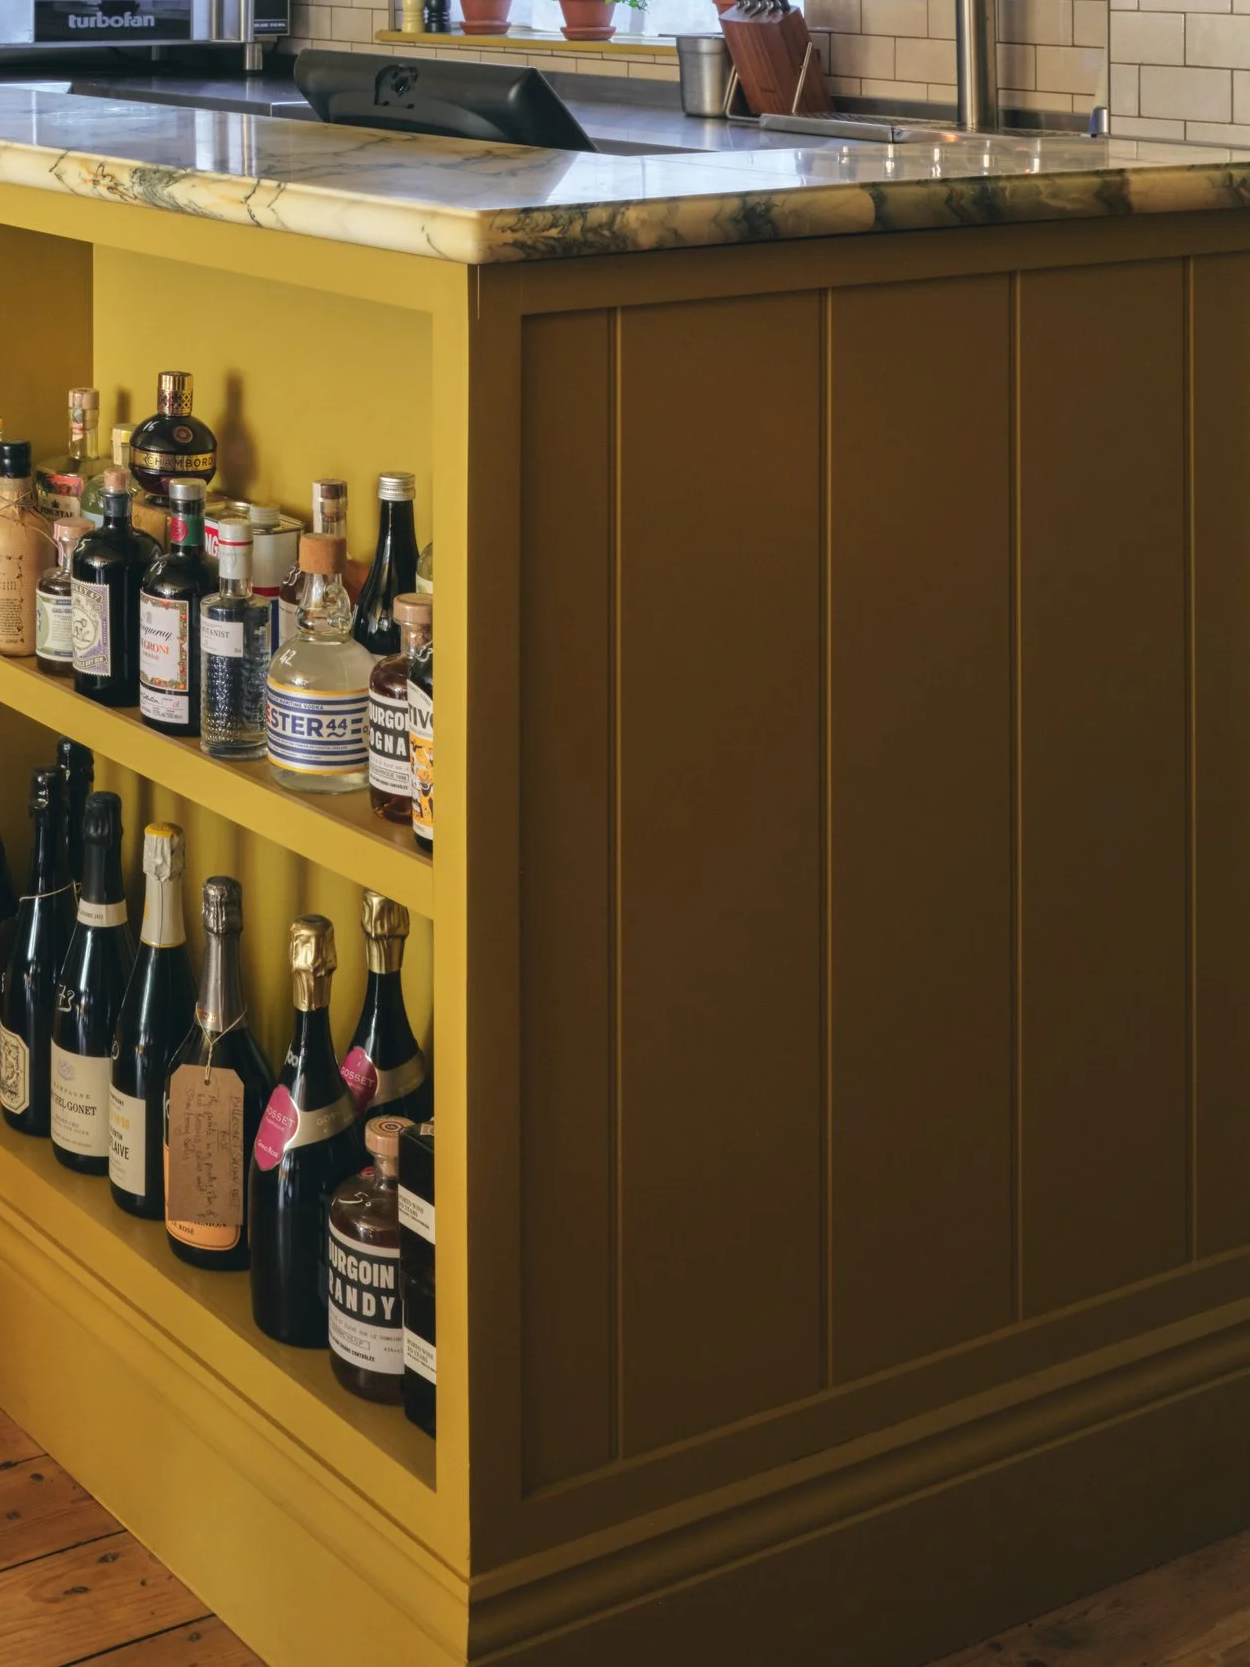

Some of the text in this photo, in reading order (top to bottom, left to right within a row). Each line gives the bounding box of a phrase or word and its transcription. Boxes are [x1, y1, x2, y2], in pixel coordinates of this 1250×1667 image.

[68, 11, 155, 28] turbofan
[145, 452, 215, 470] CHAMBORD
[326, 718, 348, 731] 44
[340, 1065, 376, 1088] GOSSET
[66, 1100, 97, 1116] GONET
